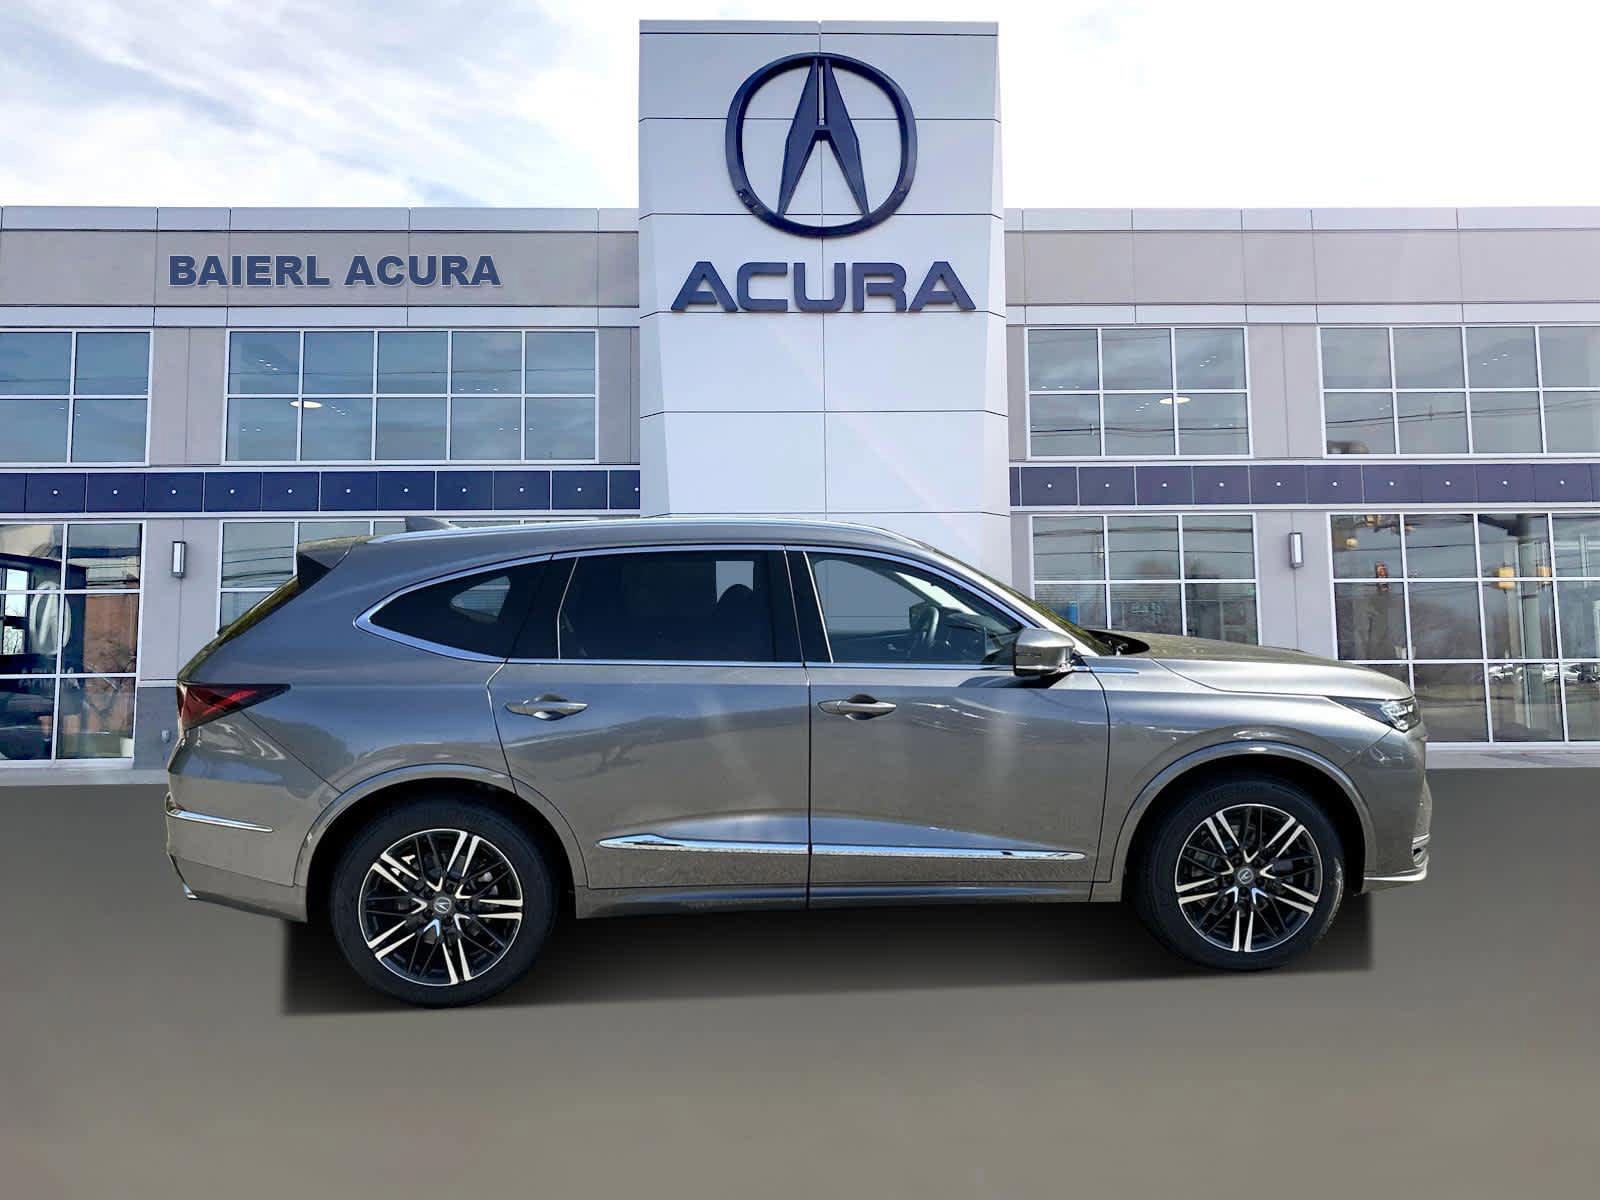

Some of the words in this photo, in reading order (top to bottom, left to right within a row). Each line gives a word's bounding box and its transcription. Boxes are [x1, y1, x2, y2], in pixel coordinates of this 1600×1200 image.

[169, 255, 331, 286] BAIERL
[344, 255, 502, 286] ACURA
[671, 261, 976, 312] ACURA
